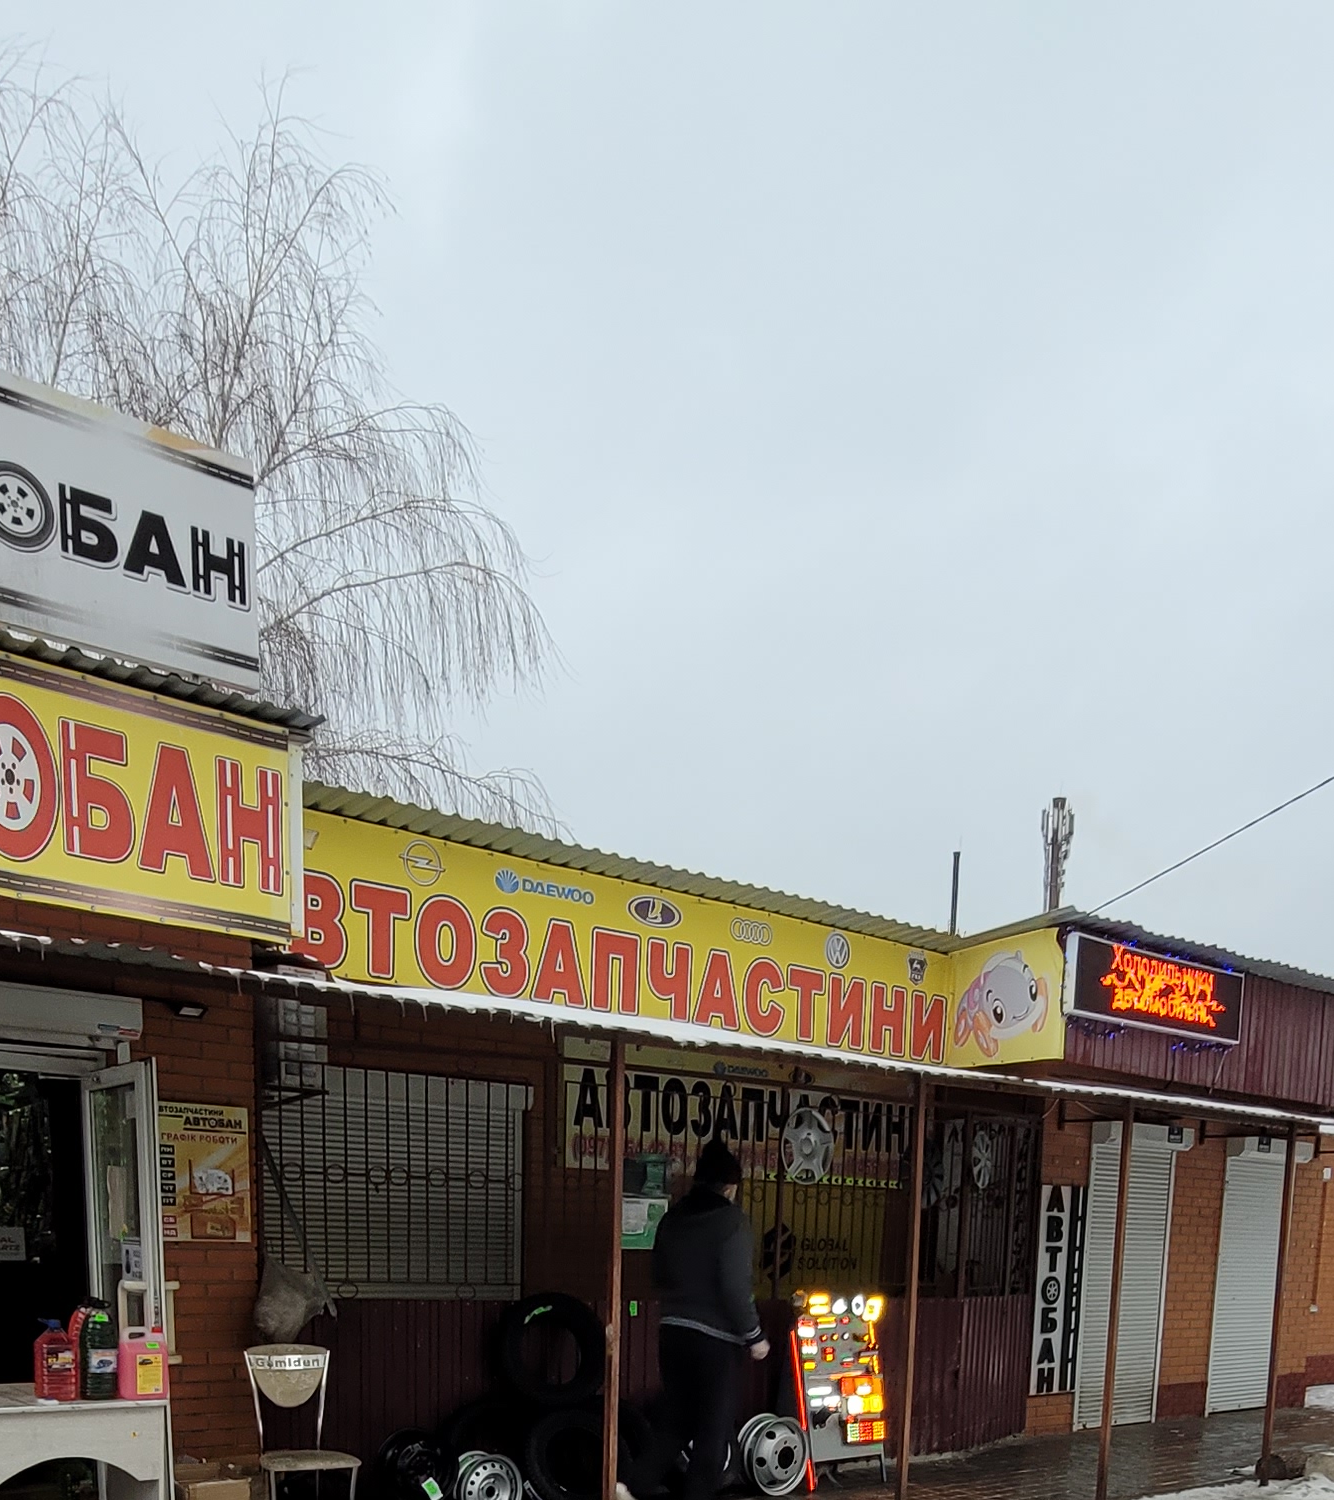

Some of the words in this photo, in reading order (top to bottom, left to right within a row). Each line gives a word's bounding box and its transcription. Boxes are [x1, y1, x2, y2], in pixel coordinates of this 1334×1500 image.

[522, 878, 595, 905] DAEWOO
[288, 868, 948, 1063] ВТОЗАПЧАСТИНИ
[183, 1116, 243, 1130] АВТОБАН
[161, 1132, 197, 1142] ГРАФІК
[199, 1134, 238, 1145] РОБОТИ
[797, 1256, 858, 1271] SOLUTON
[1036, 1185, 1065, 1394] АВТОБАН
